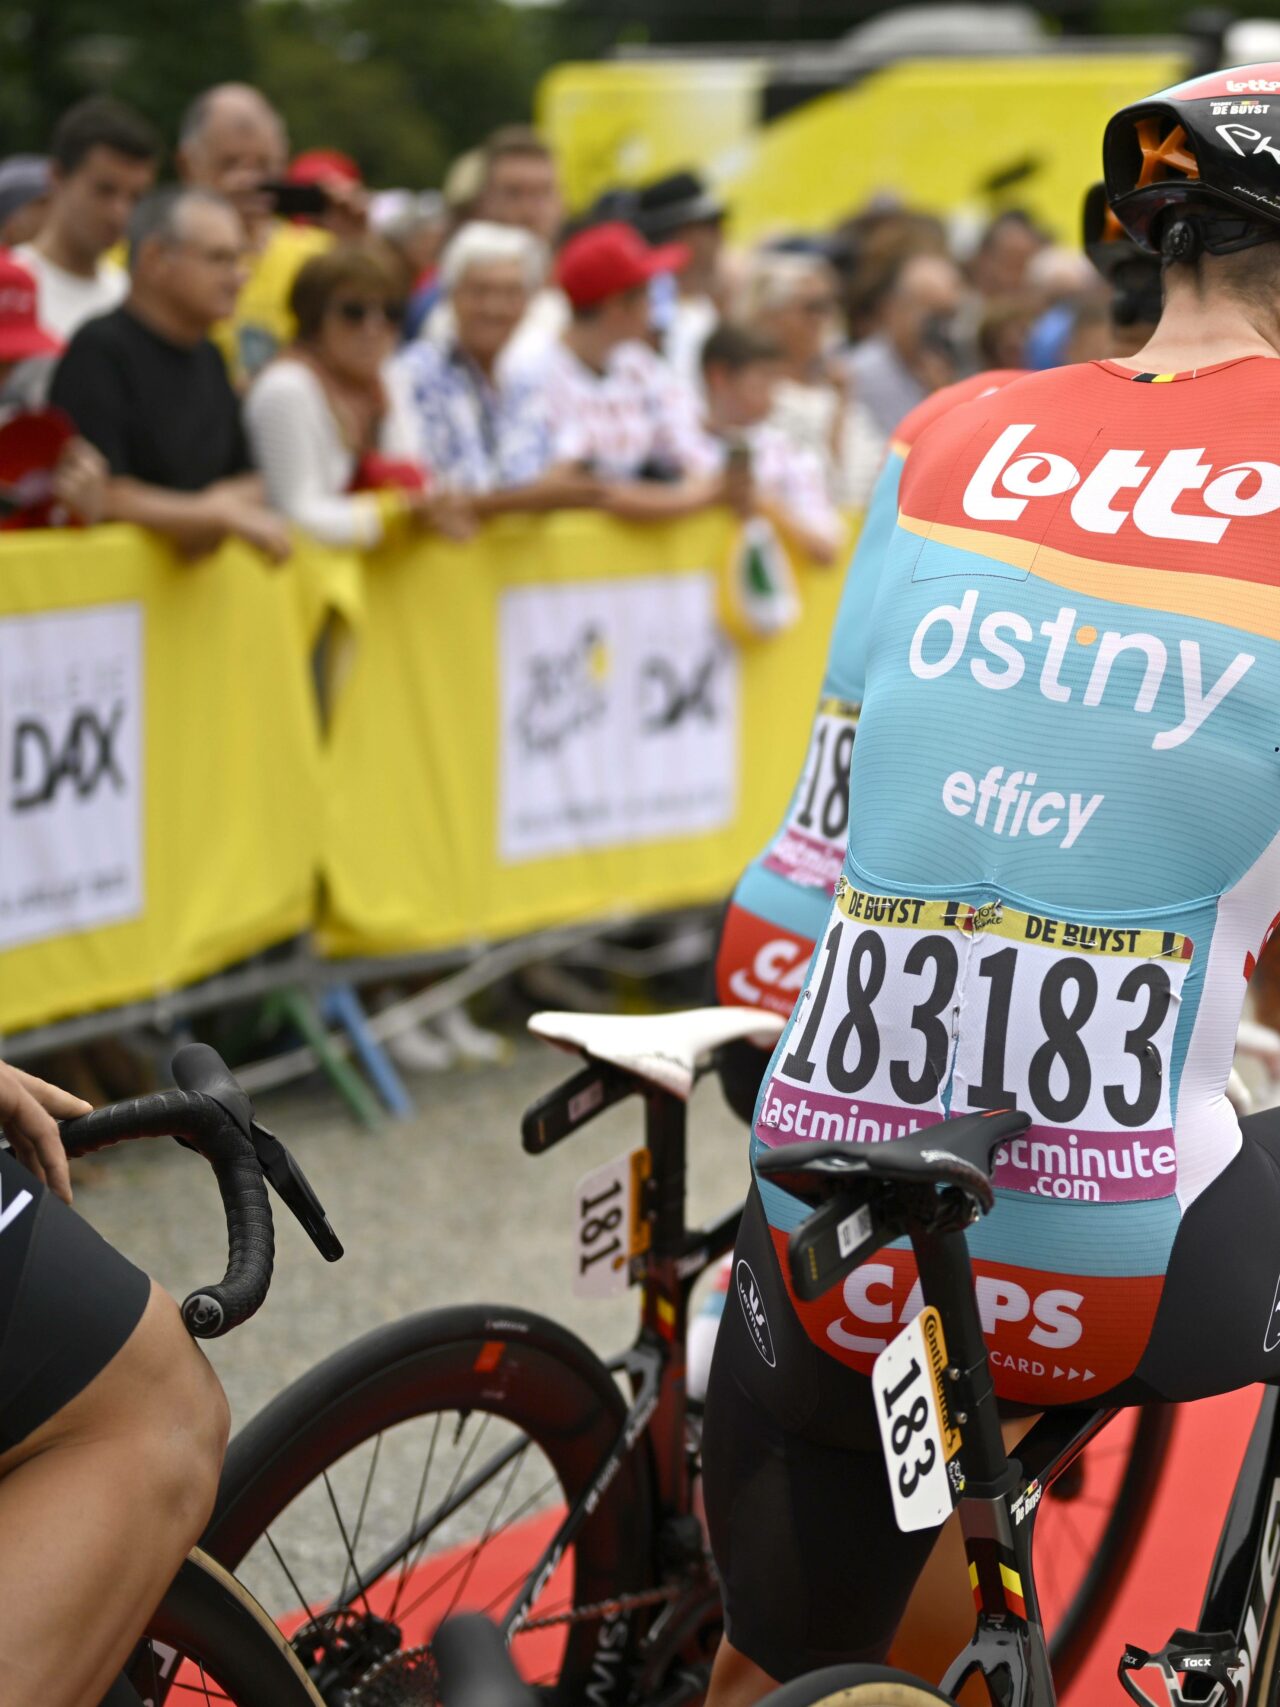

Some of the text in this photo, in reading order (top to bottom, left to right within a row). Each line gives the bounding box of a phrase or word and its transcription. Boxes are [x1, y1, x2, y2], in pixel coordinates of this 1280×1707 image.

[1212, 104, 1270, 115] DE BUYST
[908, 589, 1256, 751] dstny
[796, 720, 856, 839] 18
[942, 765, 1105, 849] efficy
[848, 890, 926, 925] DE BUYST
[1025, 915, 1142, 953] DE BUYST
[781, 920, 959, 1105] 183
[967, 946, 1171, 1128] 183
[580, 1178, 623, 1277] 181
[1029, 1176, 1100, 1201] .com
[842, 1263, 1085, 1349] CPS
[989, 1351, 1046, 1378] CARD
[883, 1356, 936, 1499] 183
[1183, 1657, 1212, 1668] Tacx
